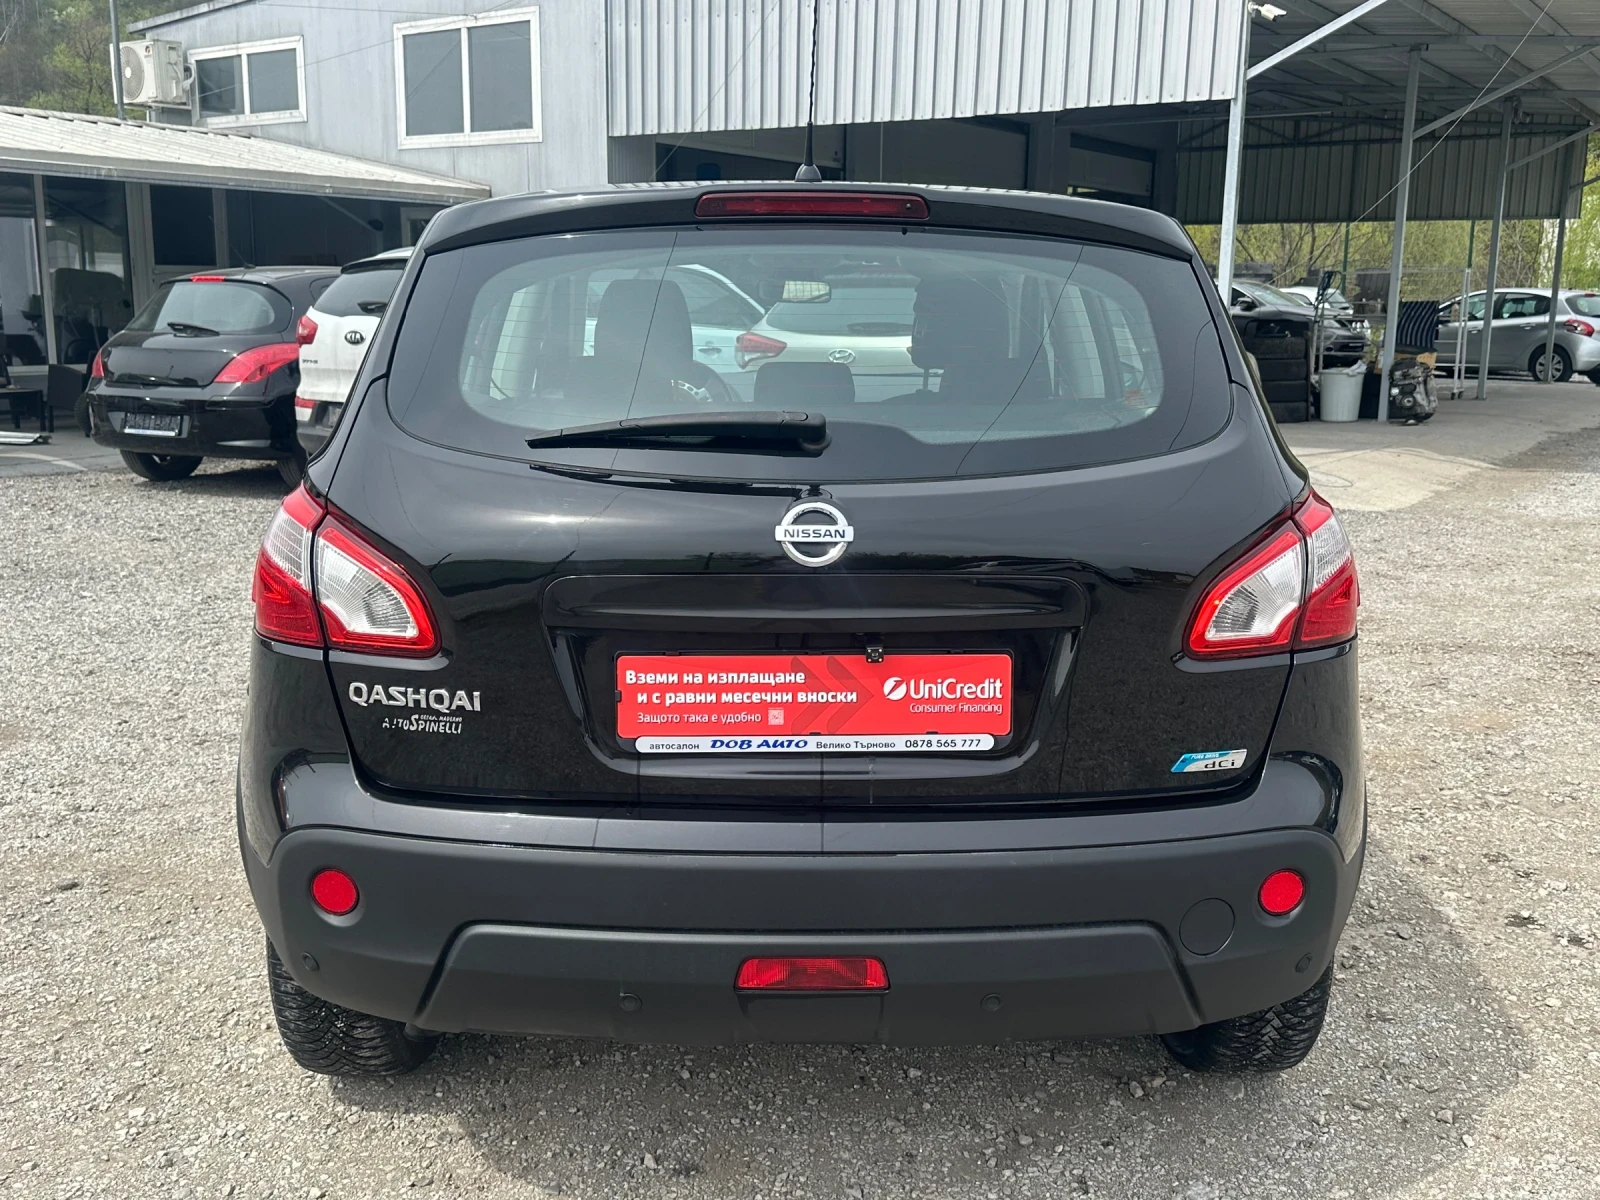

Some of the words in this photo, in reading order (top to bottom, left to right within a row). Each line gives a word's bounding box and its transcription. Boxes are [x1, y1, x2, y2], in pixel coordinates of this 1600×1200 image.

[346, 332, 361, 342] KIA
[784, 529, 845, 538] NISSAN
[625, 670, 678, 684] Вземи
[683, 673, 703, 684] на
[708, 672, 805, 686] изплащане
[909, 678, 1003, 699] UniCredit
[349, 682, 481, 713] QASHQAI
[637, 692, 648, 703] и
[652, 692, 661, 703] с
[665, 692, 717, 707] равни
[721, 692, 792, 703] месечни
[797, 692, 857, 702] вноски
[910, 703, 956, 713] Consumer
[959, 702, 1003, 714] Financing
[637, 712, 680, 724] Защото
[683, 714, 709, 723] така
[711, 714, 718, 722] е
[721, 711, 762, 724] удобно
[816, 742, 852, 750] Велико
[854, 741, 896, 751] Търново
[905, 740, 933, 748] 0878
[936, 740, 957, 748] 565
[961, 739, 981, 748] 777
[1204, 759, 1235, 769] dCi
